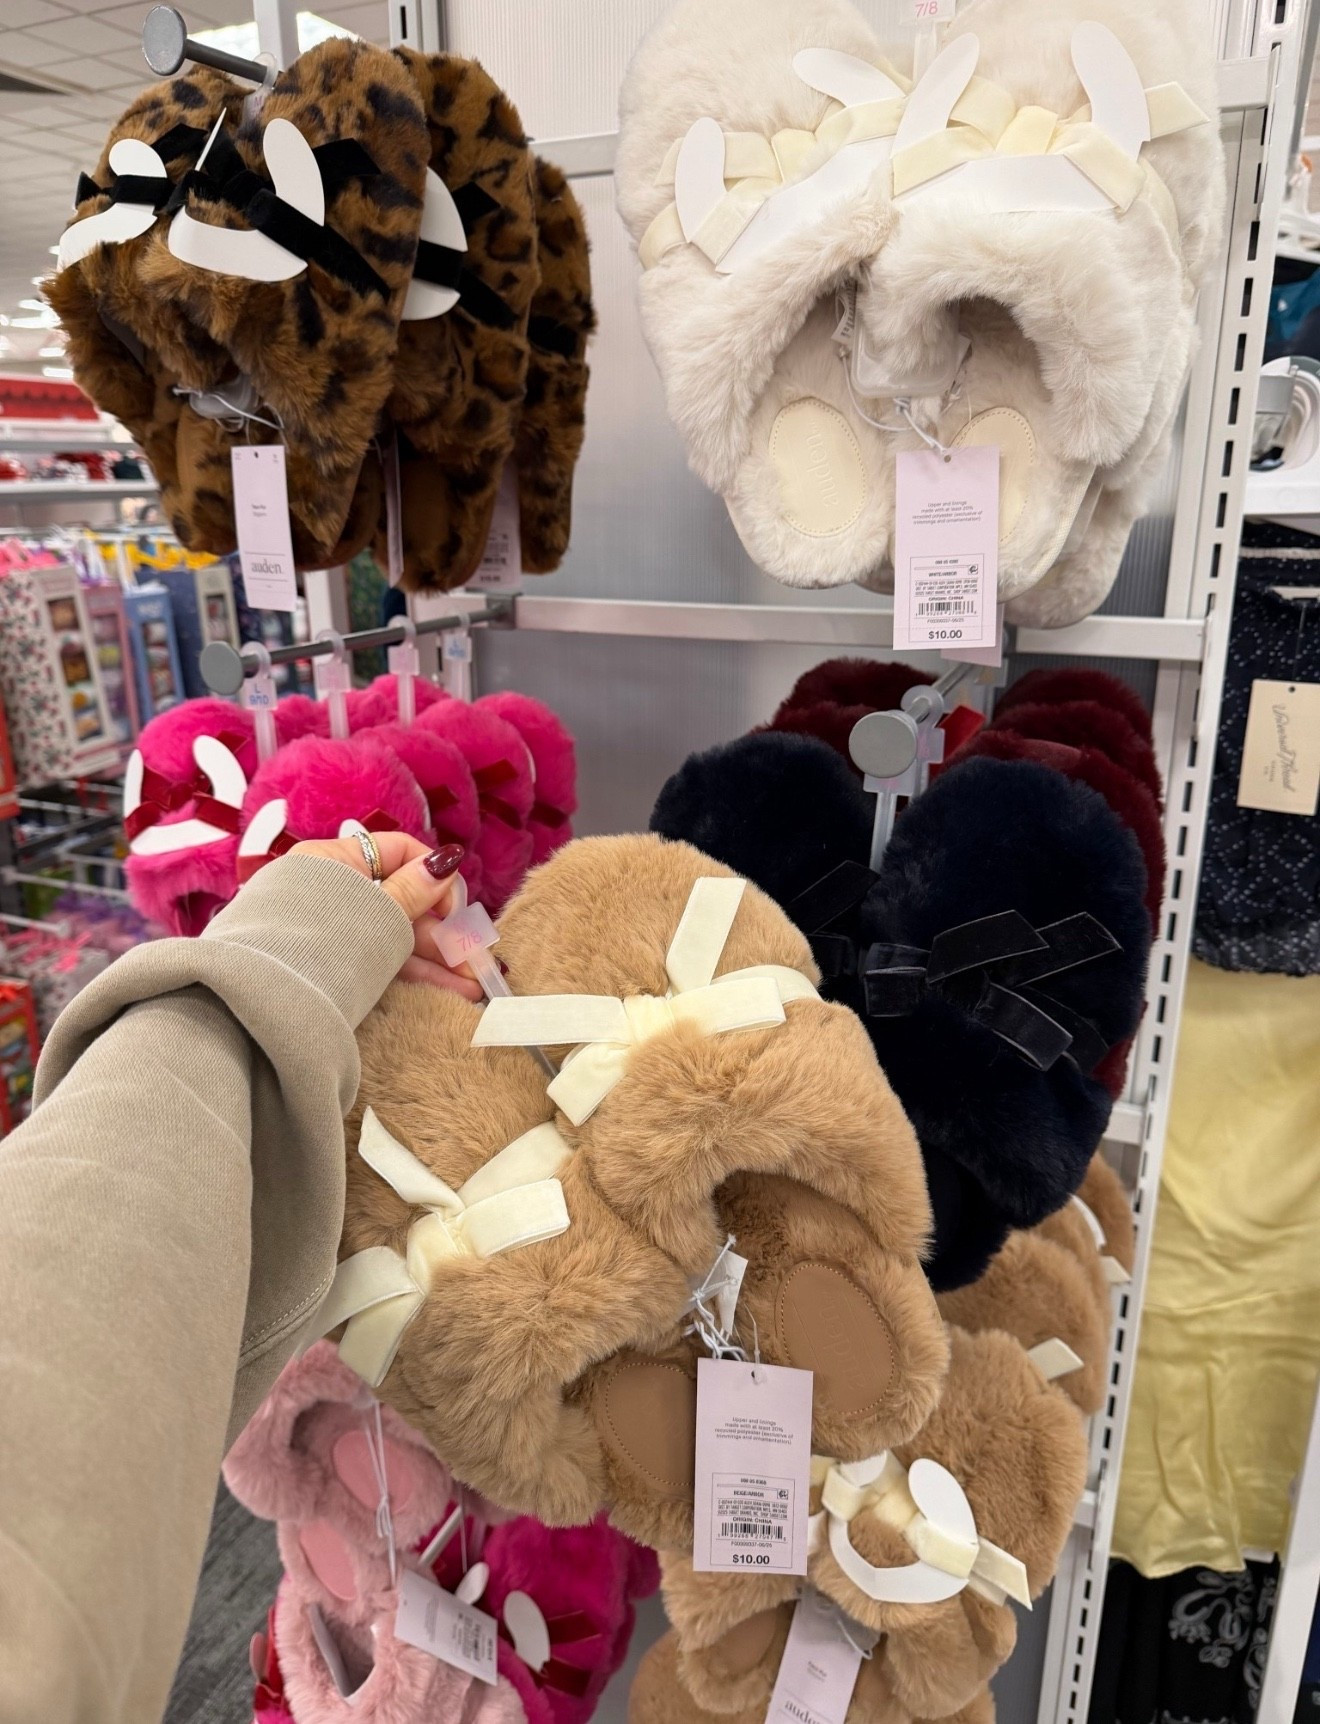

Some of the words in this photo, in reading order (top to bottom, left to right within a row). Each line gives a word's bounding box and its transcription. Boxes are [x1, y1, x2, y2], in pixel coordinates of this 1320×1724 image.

[914, 1, 938, 18] 7/8
[252, 558, 282, 574] auden
[928, 630, 962, 639] $10.00
[732, 1554, 770, 1564] $10.00
